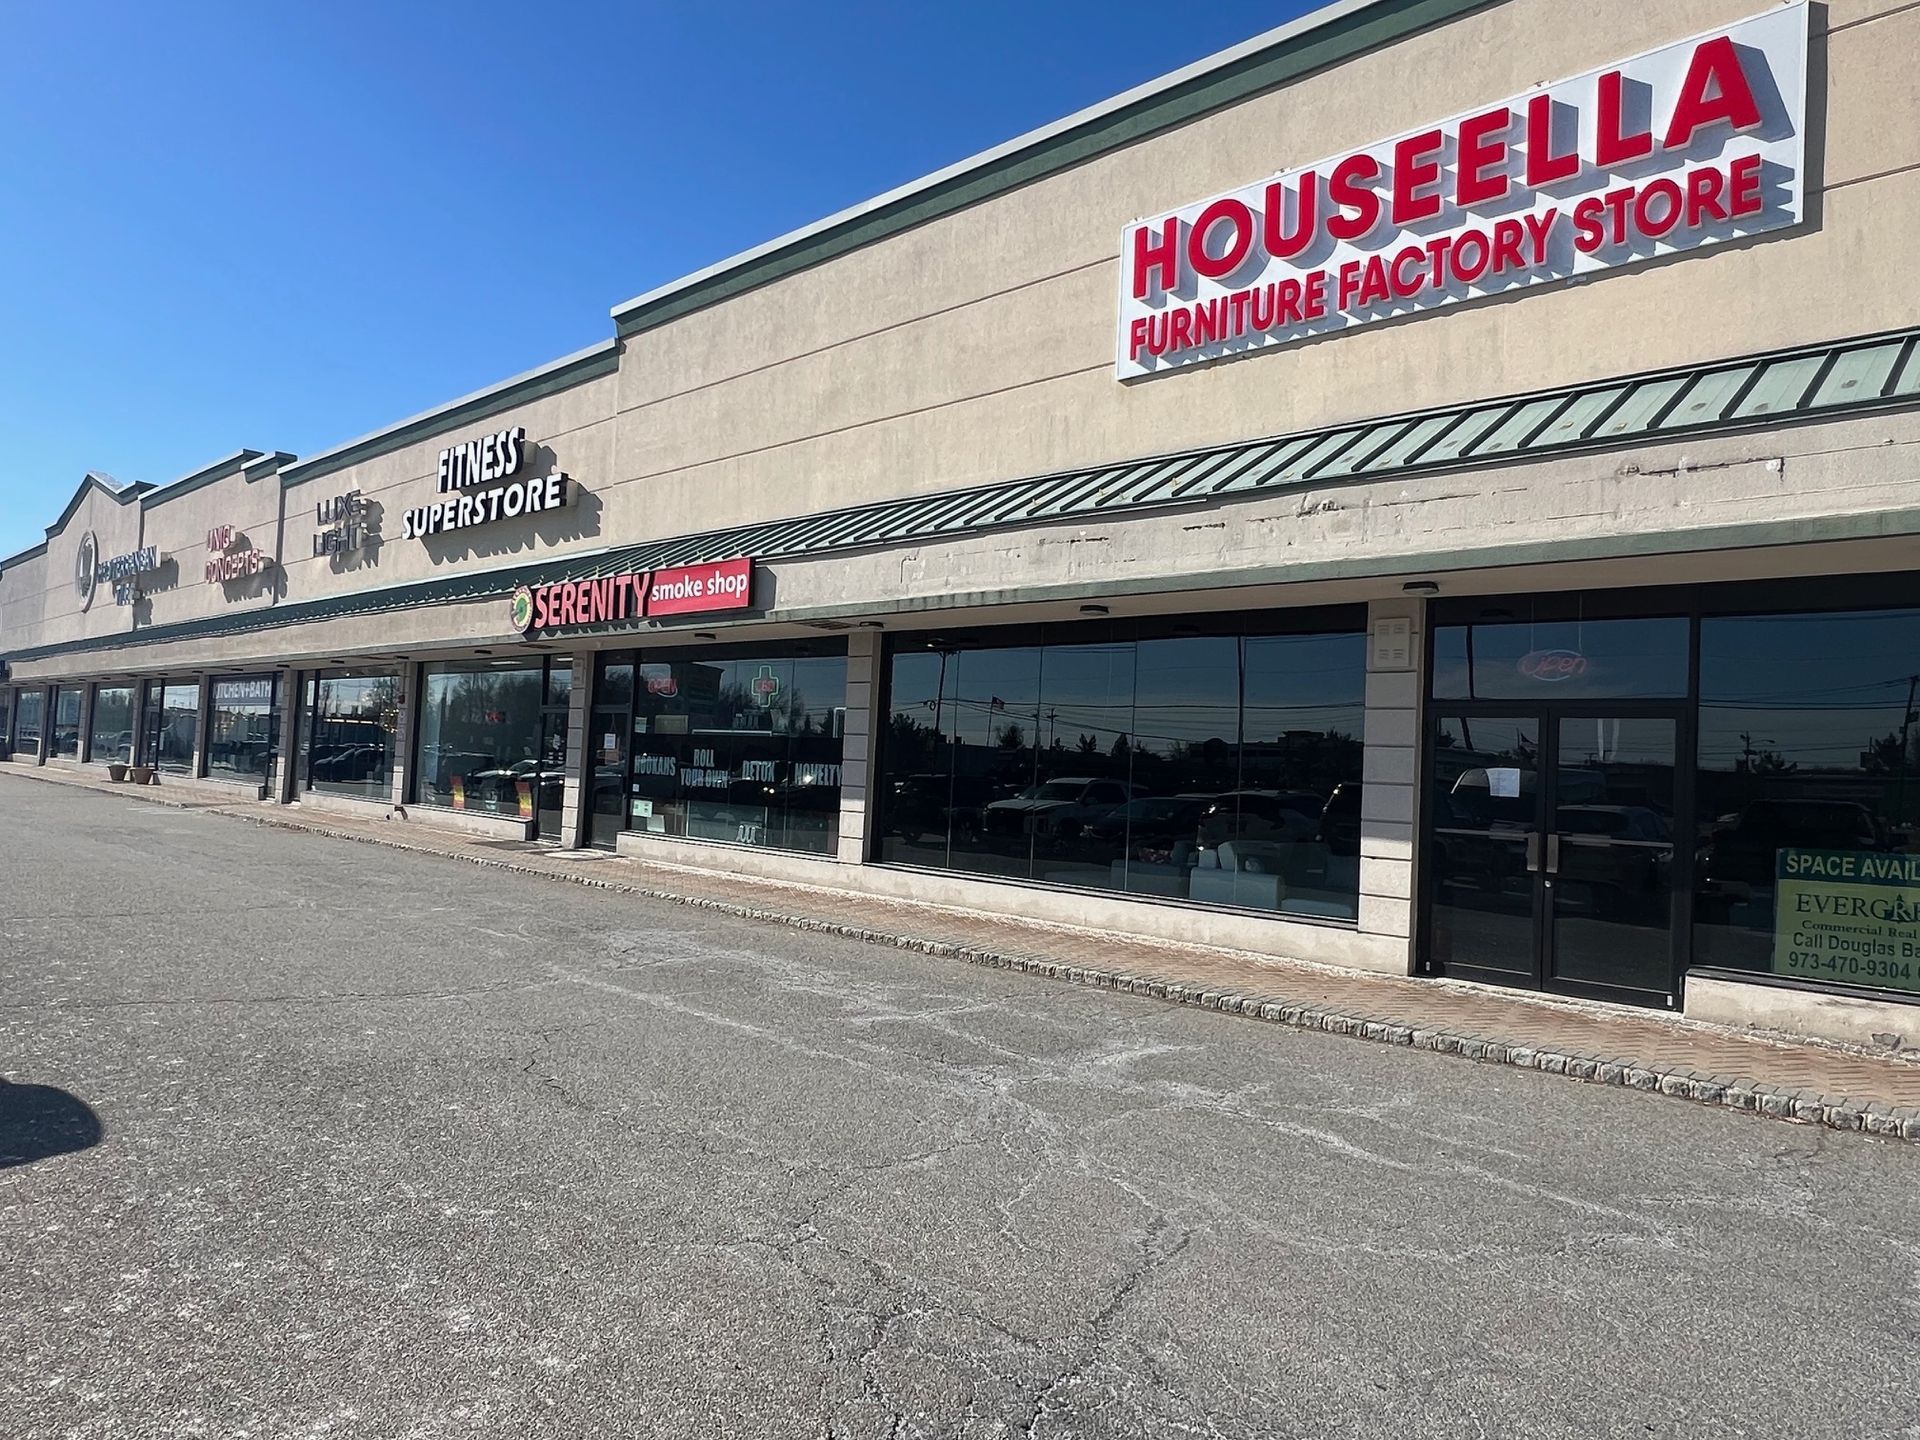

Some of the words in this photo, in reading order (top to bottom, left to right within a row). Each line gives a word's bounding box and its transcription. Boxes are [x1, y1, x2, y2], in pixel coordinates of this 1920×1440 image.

[1133, 36, 1763, 298] HOUSEELLA
[1130, 270, 1326, 361] FURNITURE
[1339, 207, 1557, 310] FACTORY
[1574, 153, 1763, 253] STORE
[436, 426, 525, 493] FITNESS
[317, 489, 363, 526] LUXE
[402, 472, 566, 540] SUPERSTORE
[313, 521, 363, 558] LIGHT
[205, 548, 260, 584] CONCEPTS
[534, 573, 651, 629] SERENITY
[652, 575, 702, 602] smoke
[707, 570, 748, 598] shop
[634, 755, 677, 777] HOOKAHS
[694, 749, 715, 768] ROLL
[742, 760, 776, 783] DETOX
[680, 768, 705, 788] YOUR
[705, 769, 729, 789] OWN
[794, 763, 843, 786] NOVELTY
[1786, 855, 1855, 877] SPACE
[1802, 920, 1882, 936] Commercial
[1888, 927, 1917, 939] Real
[1793, 932, 1823, 949] Call
[1828, 935, 1895, 957] Douglas
[1789, 951, 1911, 980] 973-470-9304
